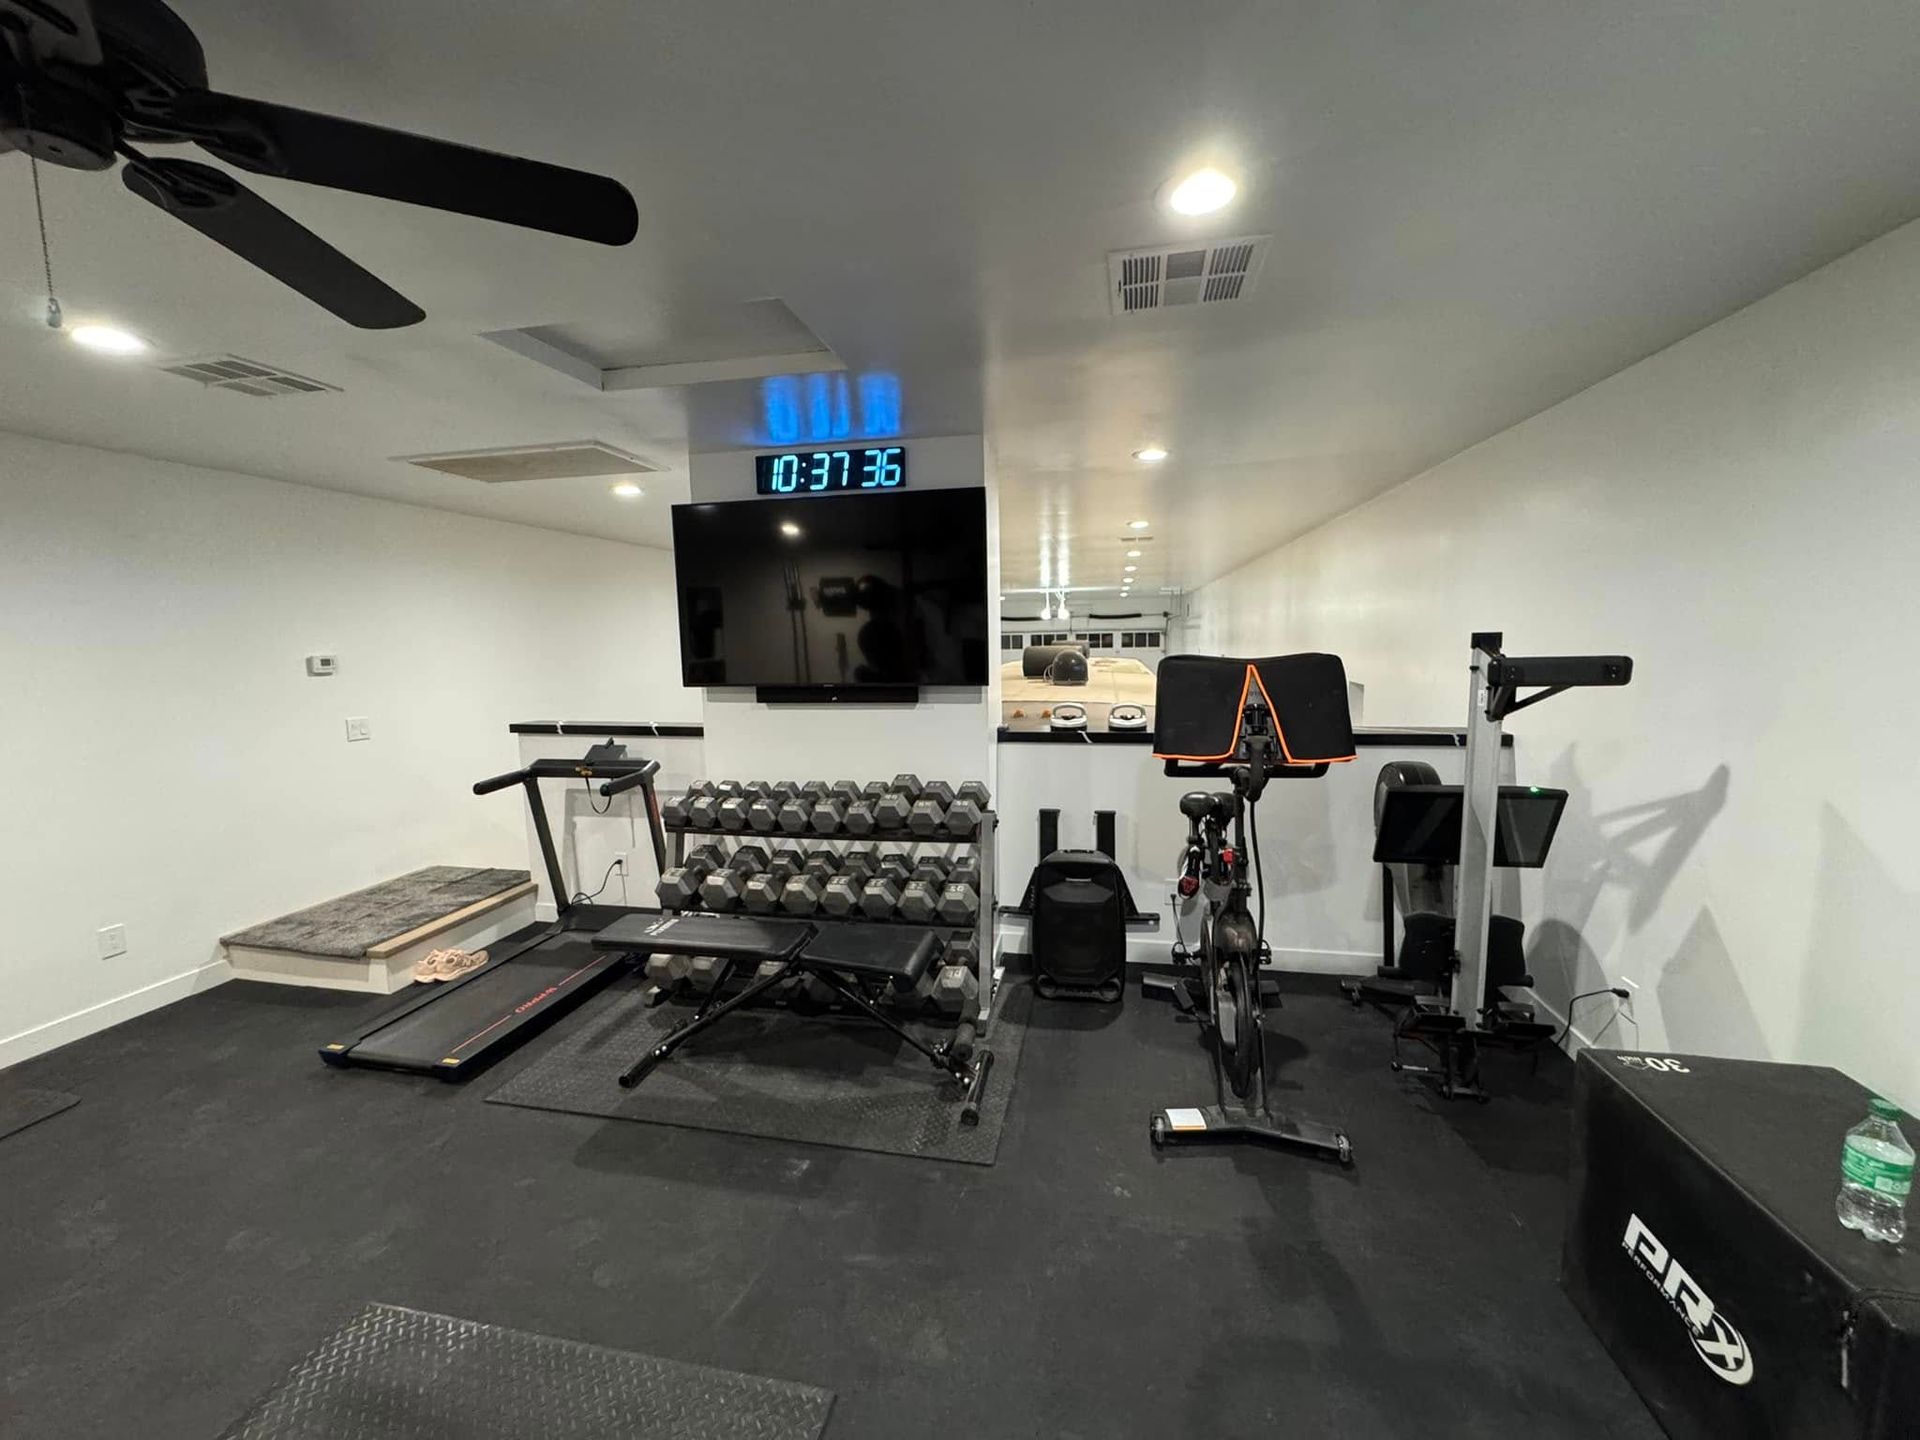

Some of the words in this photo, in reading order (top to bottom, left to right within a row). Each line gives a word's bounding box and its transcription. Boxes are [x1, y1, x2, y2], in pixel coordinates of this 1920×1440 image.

[771, 451, 850, 492] 10:37
[861, 448, 901, 487] 36
[1644, 1056, 1690, 1073] 30
[1621, 1240, 1702, 1337] PERFORMANCE
